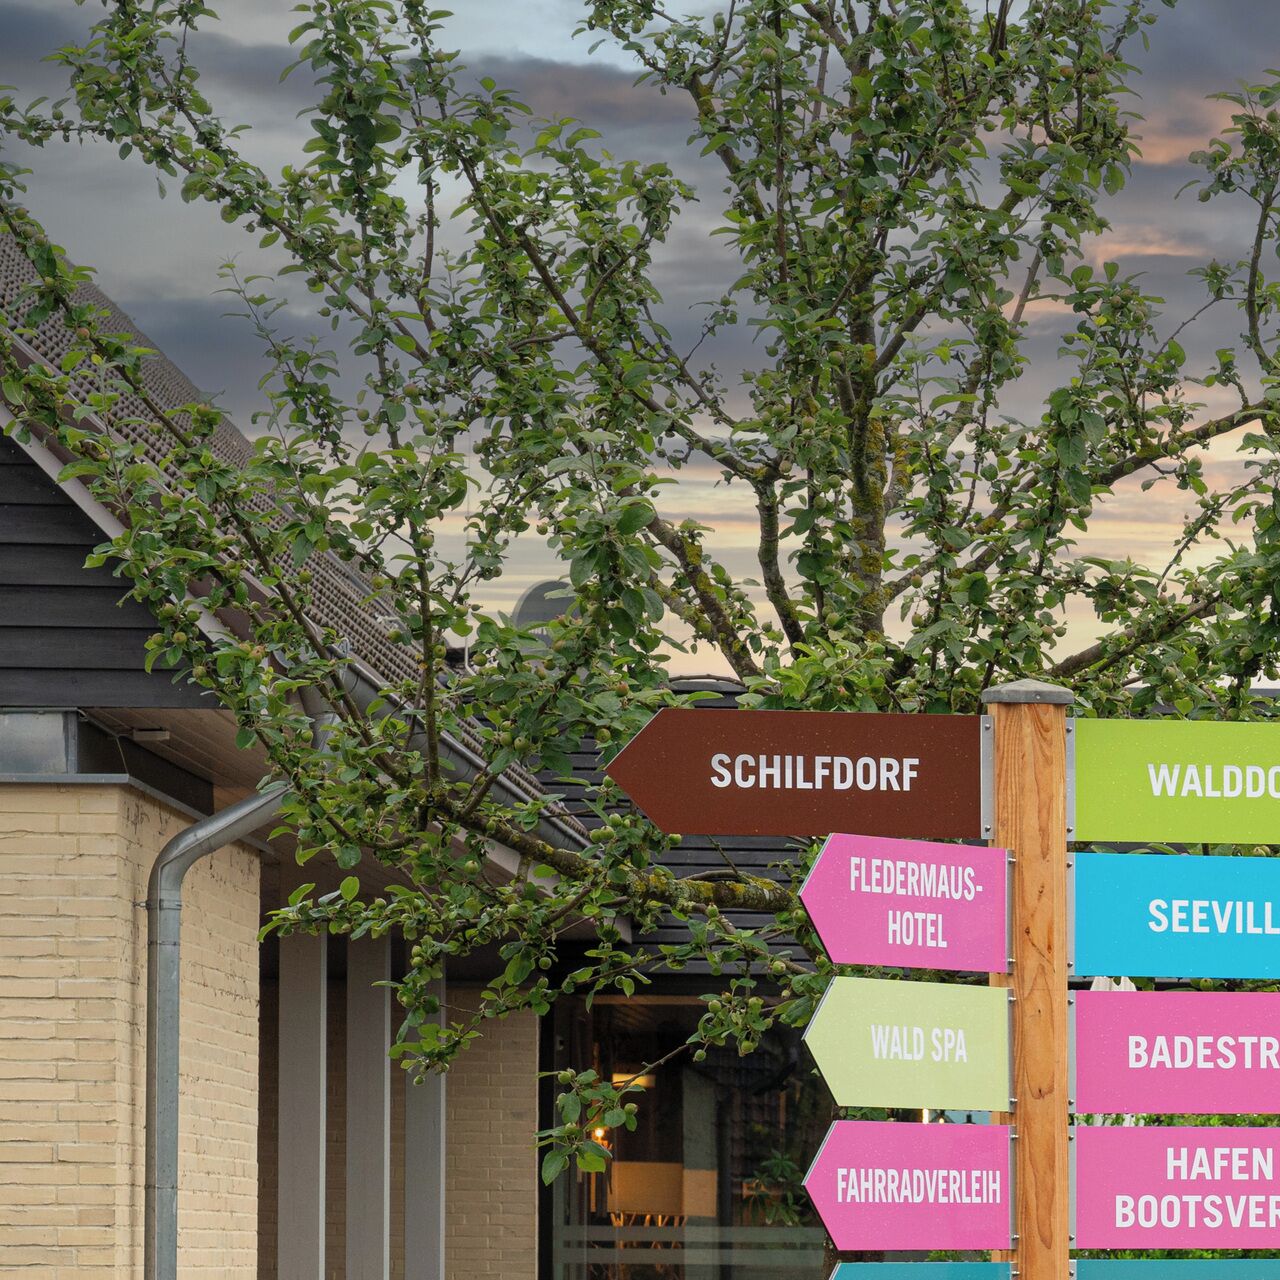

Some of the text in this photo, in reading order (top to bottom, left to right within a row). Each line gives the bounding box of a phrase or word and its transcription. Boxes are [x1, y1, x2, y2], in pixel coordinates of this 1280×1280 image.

[710, 753, 920, 792] SCHILFDORF
[850, 856, 983, 901] FLEDERMAUS-
[888, 910, 948, 948] HOTEL
[870, 1023, 968, 1063] WALD SPA
[1166, 1147, 1273, 1181] HAFEN
[837, 1167, 1001, 1204] FAHRRADVERLEIH
